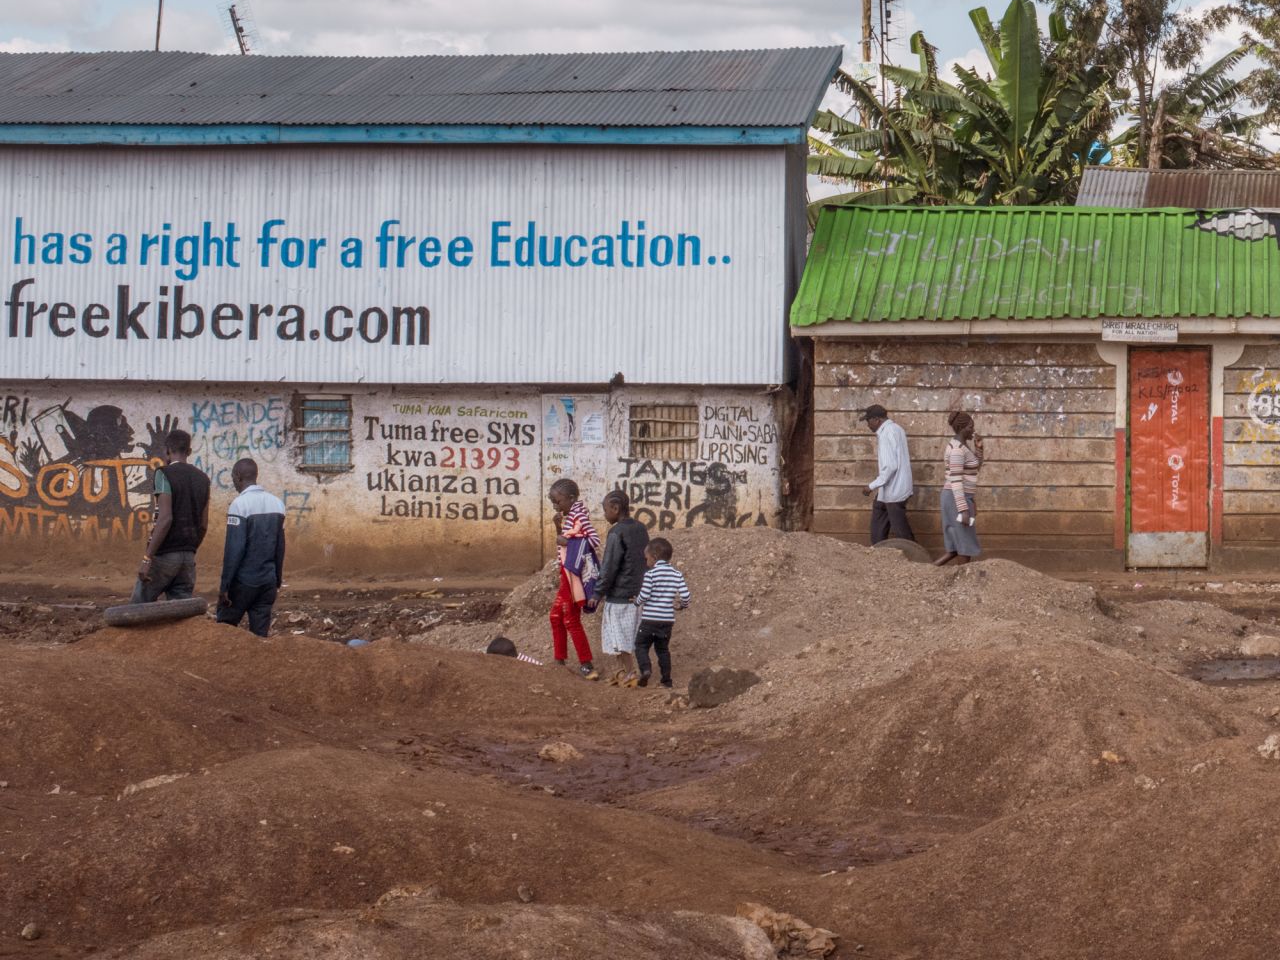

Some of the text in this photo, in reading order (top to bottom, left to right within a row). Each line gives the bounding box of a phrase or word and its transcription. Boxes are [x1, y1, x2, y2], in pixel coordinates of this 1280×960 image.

[13, 217, 92, 265] has
[106, 233, 127, 265] a
[139, 223, 240, 281] right
[257, 219, 327, 269] for
[340, 237, 363, 269] a
[375, 219, 474, 268] free
[4, 278, 431, 346] freekibera.com
[0, 395, 29, 427] RI
[393, 404, 422, 415] TUMA
[428, 405, 452, 416] KWA
[363, 415, 428, 441] Tuma
[430, 419, 480, 444] free
[487, 421, 536, 446] SMS
[386, 443, 520, 471] kwa 21393
[701, 441, 768, 465] UPRISING
[366, 468, 521, 495] ukianza na
[1171, 471, 1180, 509] TOTAL
